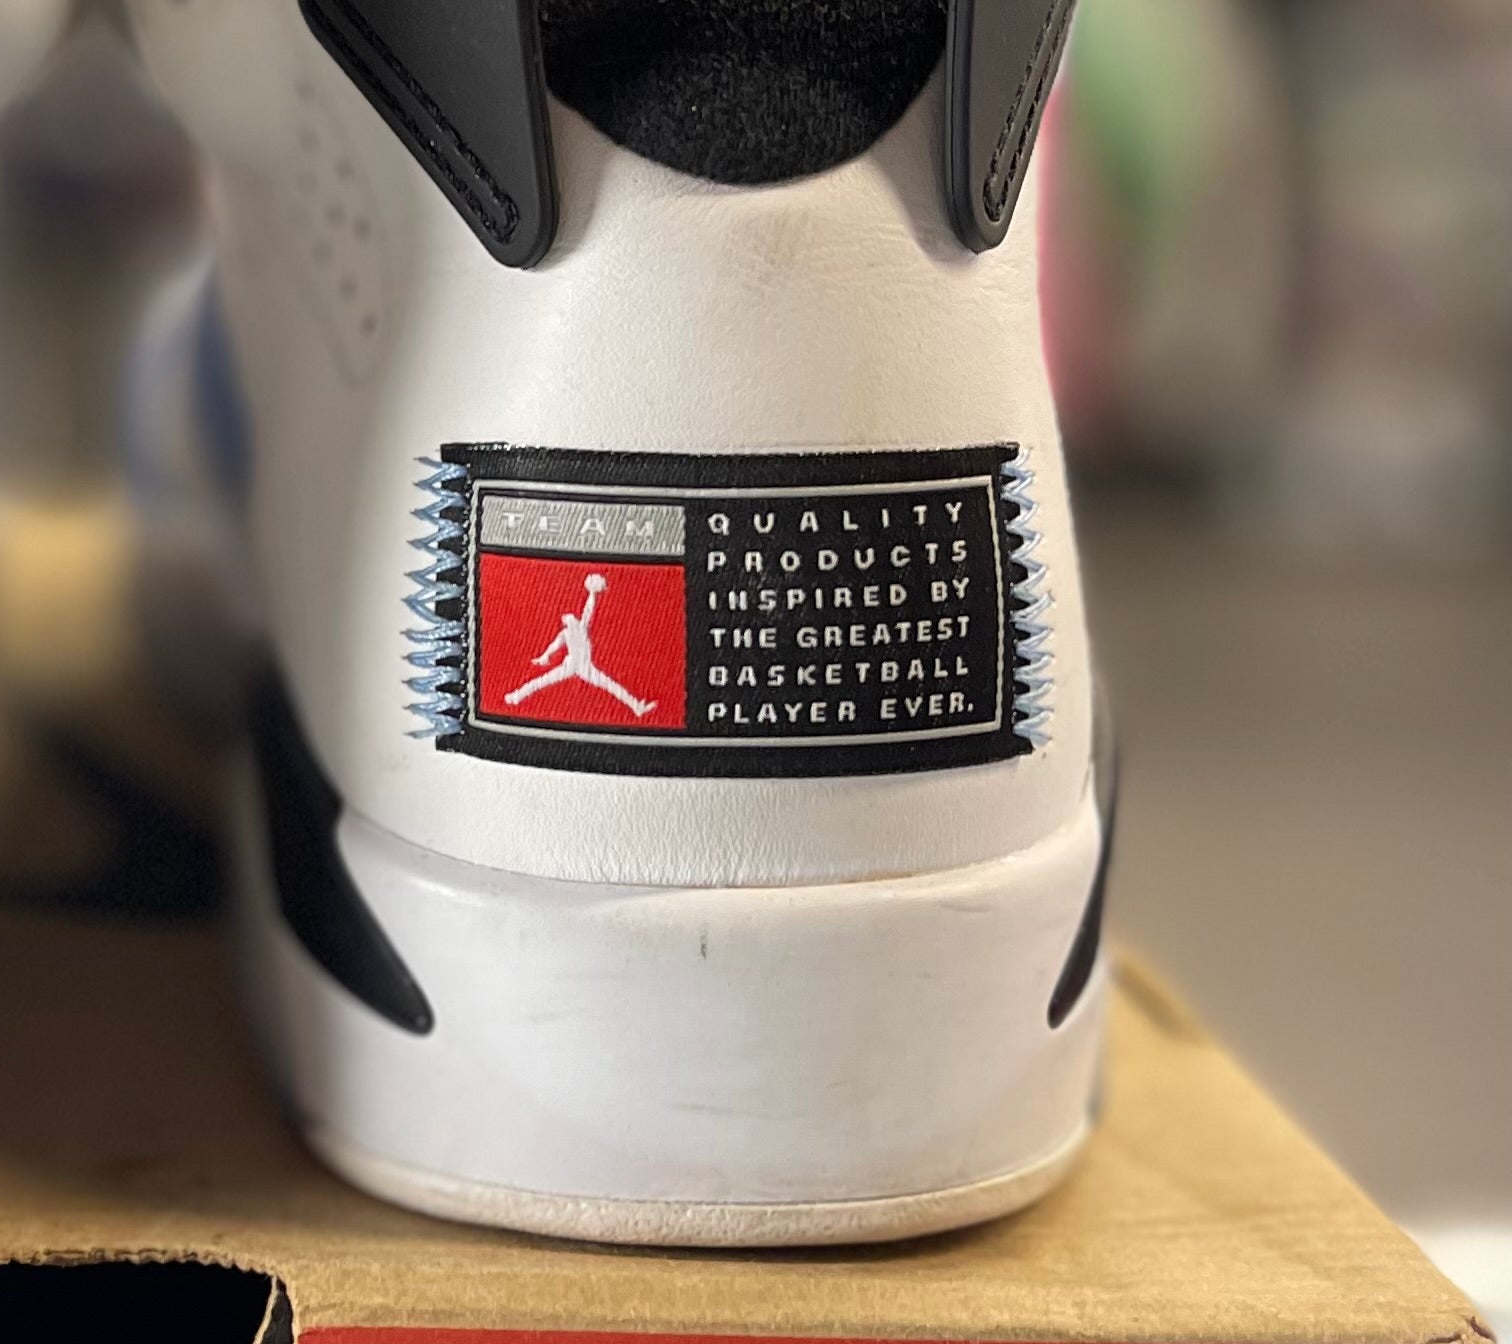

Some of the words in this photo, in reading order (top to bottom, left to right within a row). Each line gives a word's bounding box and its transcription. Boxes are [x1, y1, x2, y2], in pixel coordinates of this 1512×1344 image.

[503, 512, 654, 538] TEAM
[707, 501, 964, 536] QUALITY
[707, 540, 967, 572] PRODUCTS
[708, 584, 907, 612] INSPIRED
[931, 578, 969, 603] BY
[709, 627, 777, 649] THE
[797, 615, 970, 648] GREATEST
[708, 658, 969, 689] BASKETBALL
[708, 700, 858, 725] PLAYER
[880, 691, 975, 720] EVER.
